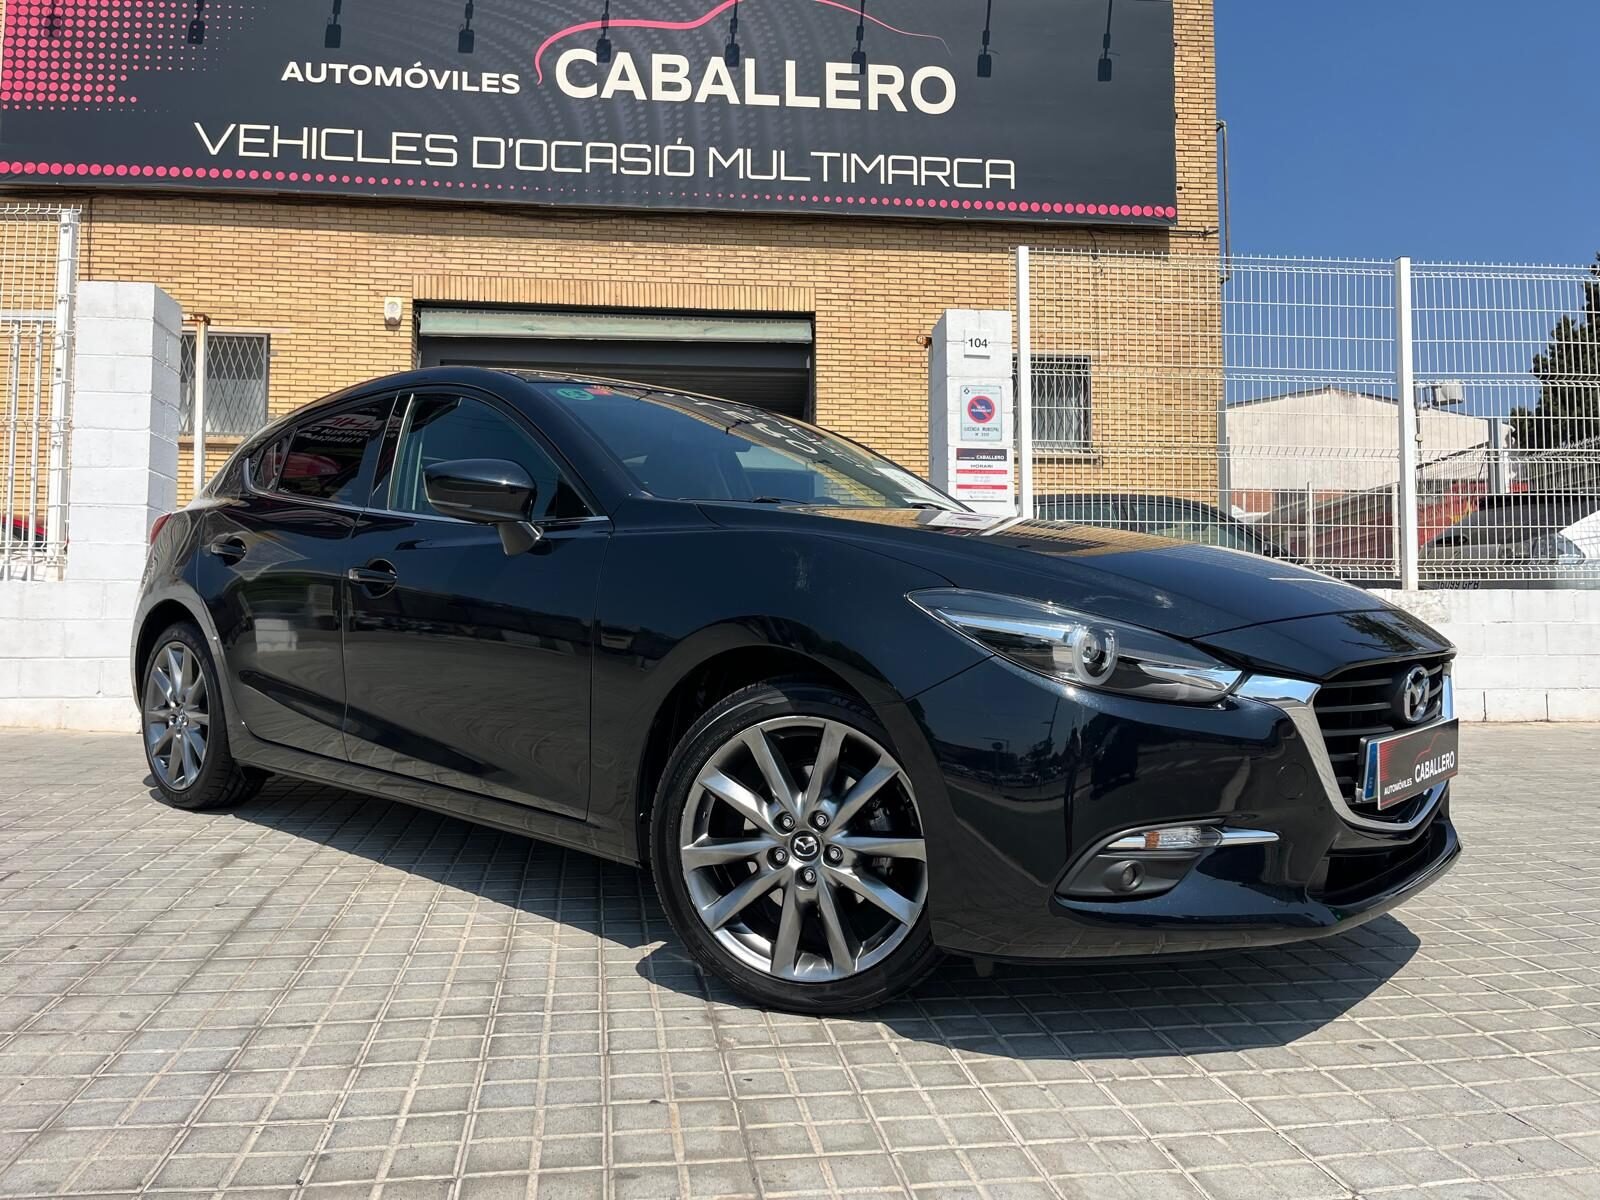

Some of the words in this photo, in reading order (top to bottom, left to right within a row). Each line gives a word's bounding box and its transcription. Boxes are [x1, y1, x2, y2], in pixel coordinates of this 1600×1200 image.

[281, 61, 521, 95] AUTOMÓVILES
[555, 48, 957, 115] CABALLERO
[194, 122, 458, 168] VEHICLES
[472, 136, 695, 177] D'OCASIÓ
[708, 147, 1016, 190] MULTIMARCA
[968, 337, 988, 349] 104
[1384, 777, 1413, 796] AUTOMÓVILES
[1415, 750, 1455, 783] CABALLERO
